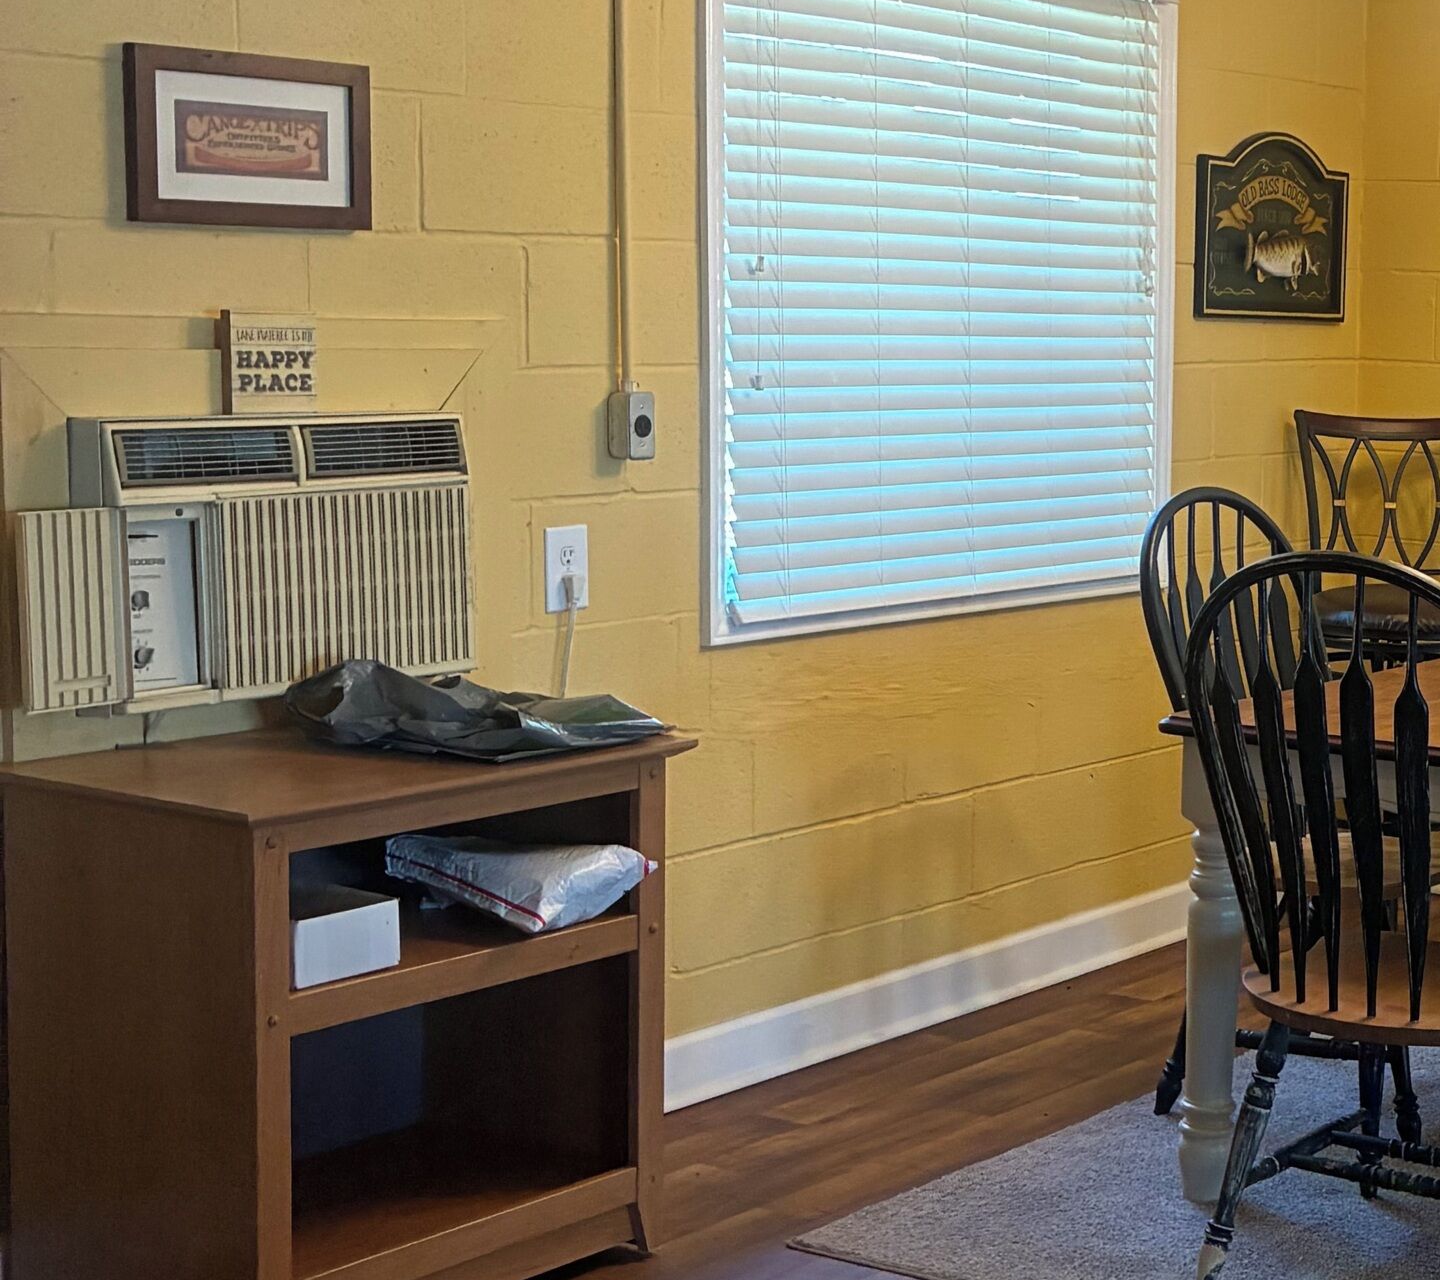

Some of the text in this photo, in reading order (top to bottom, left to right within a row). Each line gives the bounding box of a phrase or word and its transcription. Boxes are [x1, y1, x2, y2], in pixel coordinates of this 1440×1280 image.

[1241, 178, 1307, 210] OLD BASS LODGE
[236, 350, 314, 369] HAPPY
[238, 373, 312, 392] PLACE
